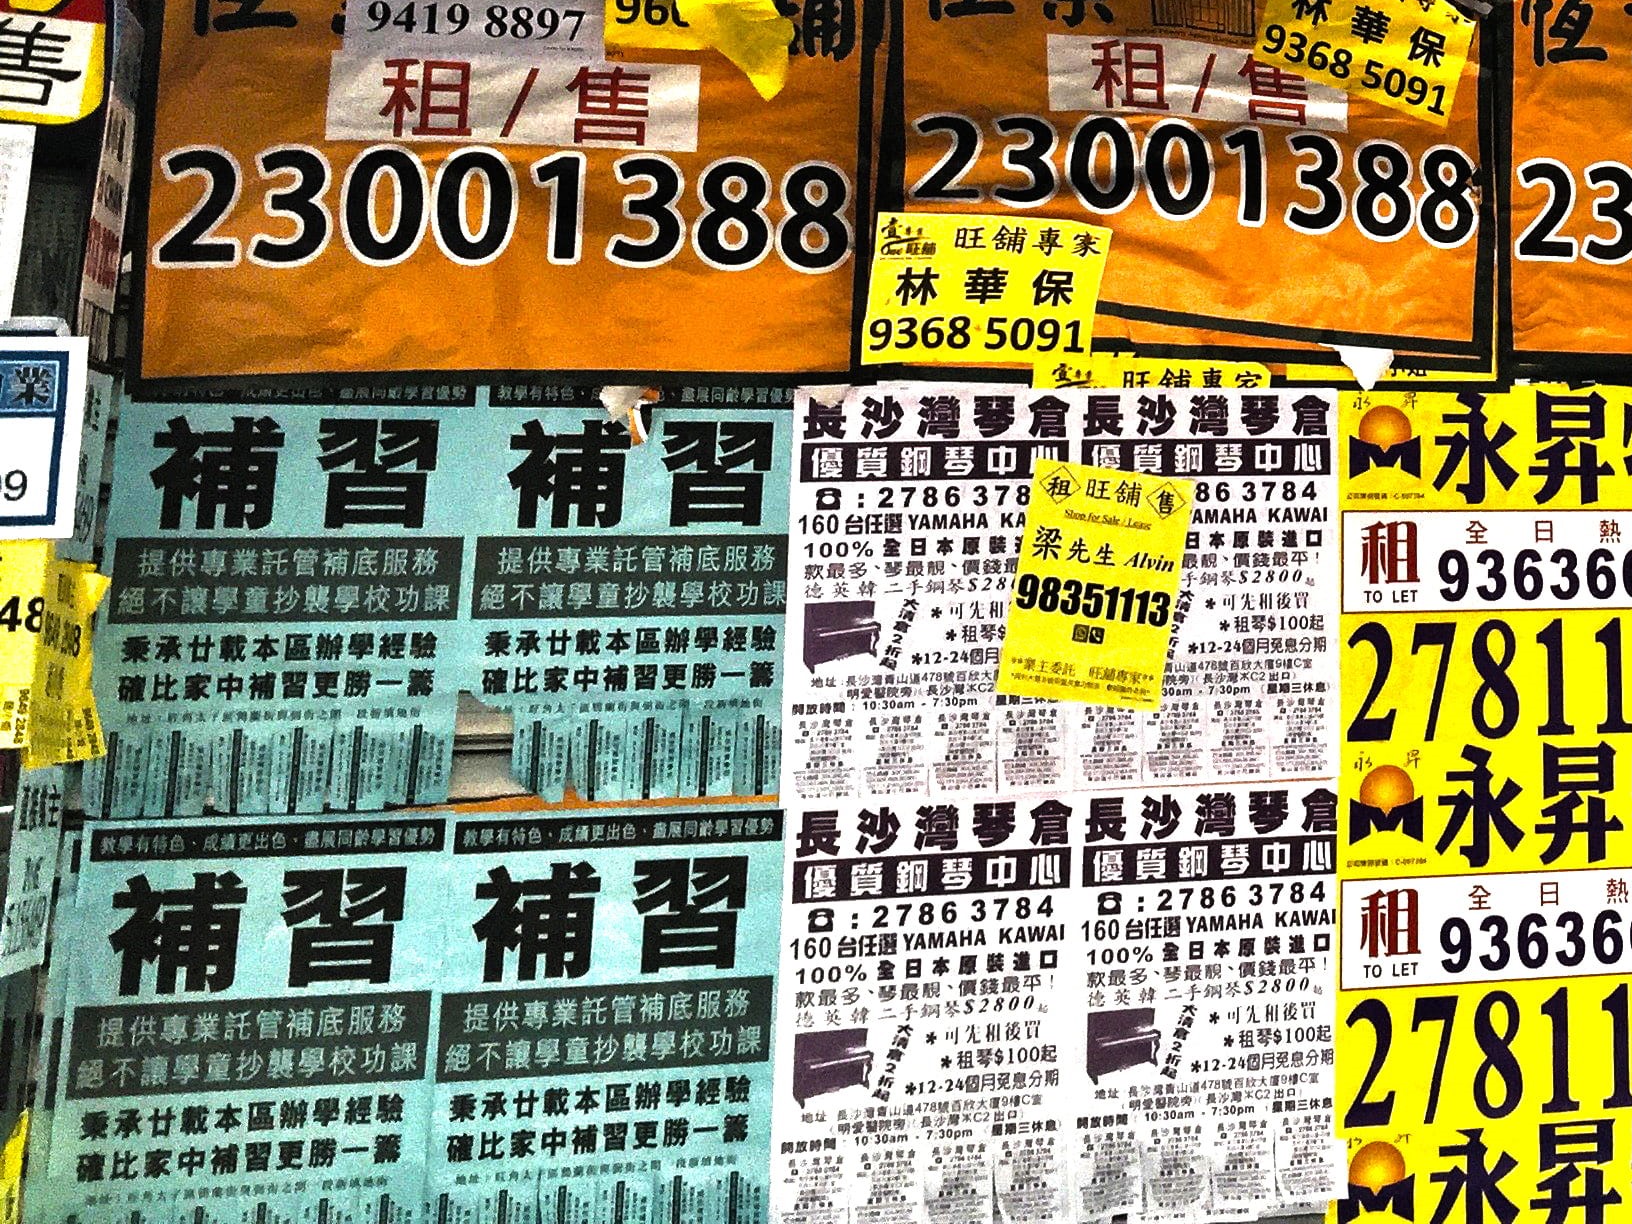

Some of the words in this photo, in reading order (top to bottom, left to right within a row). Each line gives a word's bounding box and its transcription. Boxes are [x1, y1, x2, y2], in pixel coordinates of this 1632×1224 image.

[364, 1, 471, 36] 9419
[483, 5, 587, 43] 8897
[1261, 23, 1352, 85] 9368
[1359, 65, 1448, 118] 5091
[907, 112, 1478, 251] 23001388
[152, 145, 854, 274] 23001388
[953, 225, 1103, 259] 旺舖專家
[895, 265, 1076, 308] 林華保
[867, 317, 970, 352] 9368
[983, 318, 1086, 354] 5091
[149, 416, 440, 532] 補習
[1123, 552, 1175, 574] Alvin
[1015, 572, 1171, 629] 98351113
[1363, 589, 1385, 605] TO
[1390, 588, 1418, 604] LET
[795, 800, 1074, 858] 長沙灣琴倉
[803, 854, 1062, 899] 優質鋼琴中心
[471, 854, 750, 984] 補習
[871, 902, 959, 929] 2786
[969, 894, 1055, 922] 3784
[789, 936, 831, 960] 160
[902, 927, 987, 952] YAMAHA
[998, 923, 1065, 945] KAWAI
[795, 964, 868, 985] 100%
[925, 1126, 974, 1142] 7:30pm
